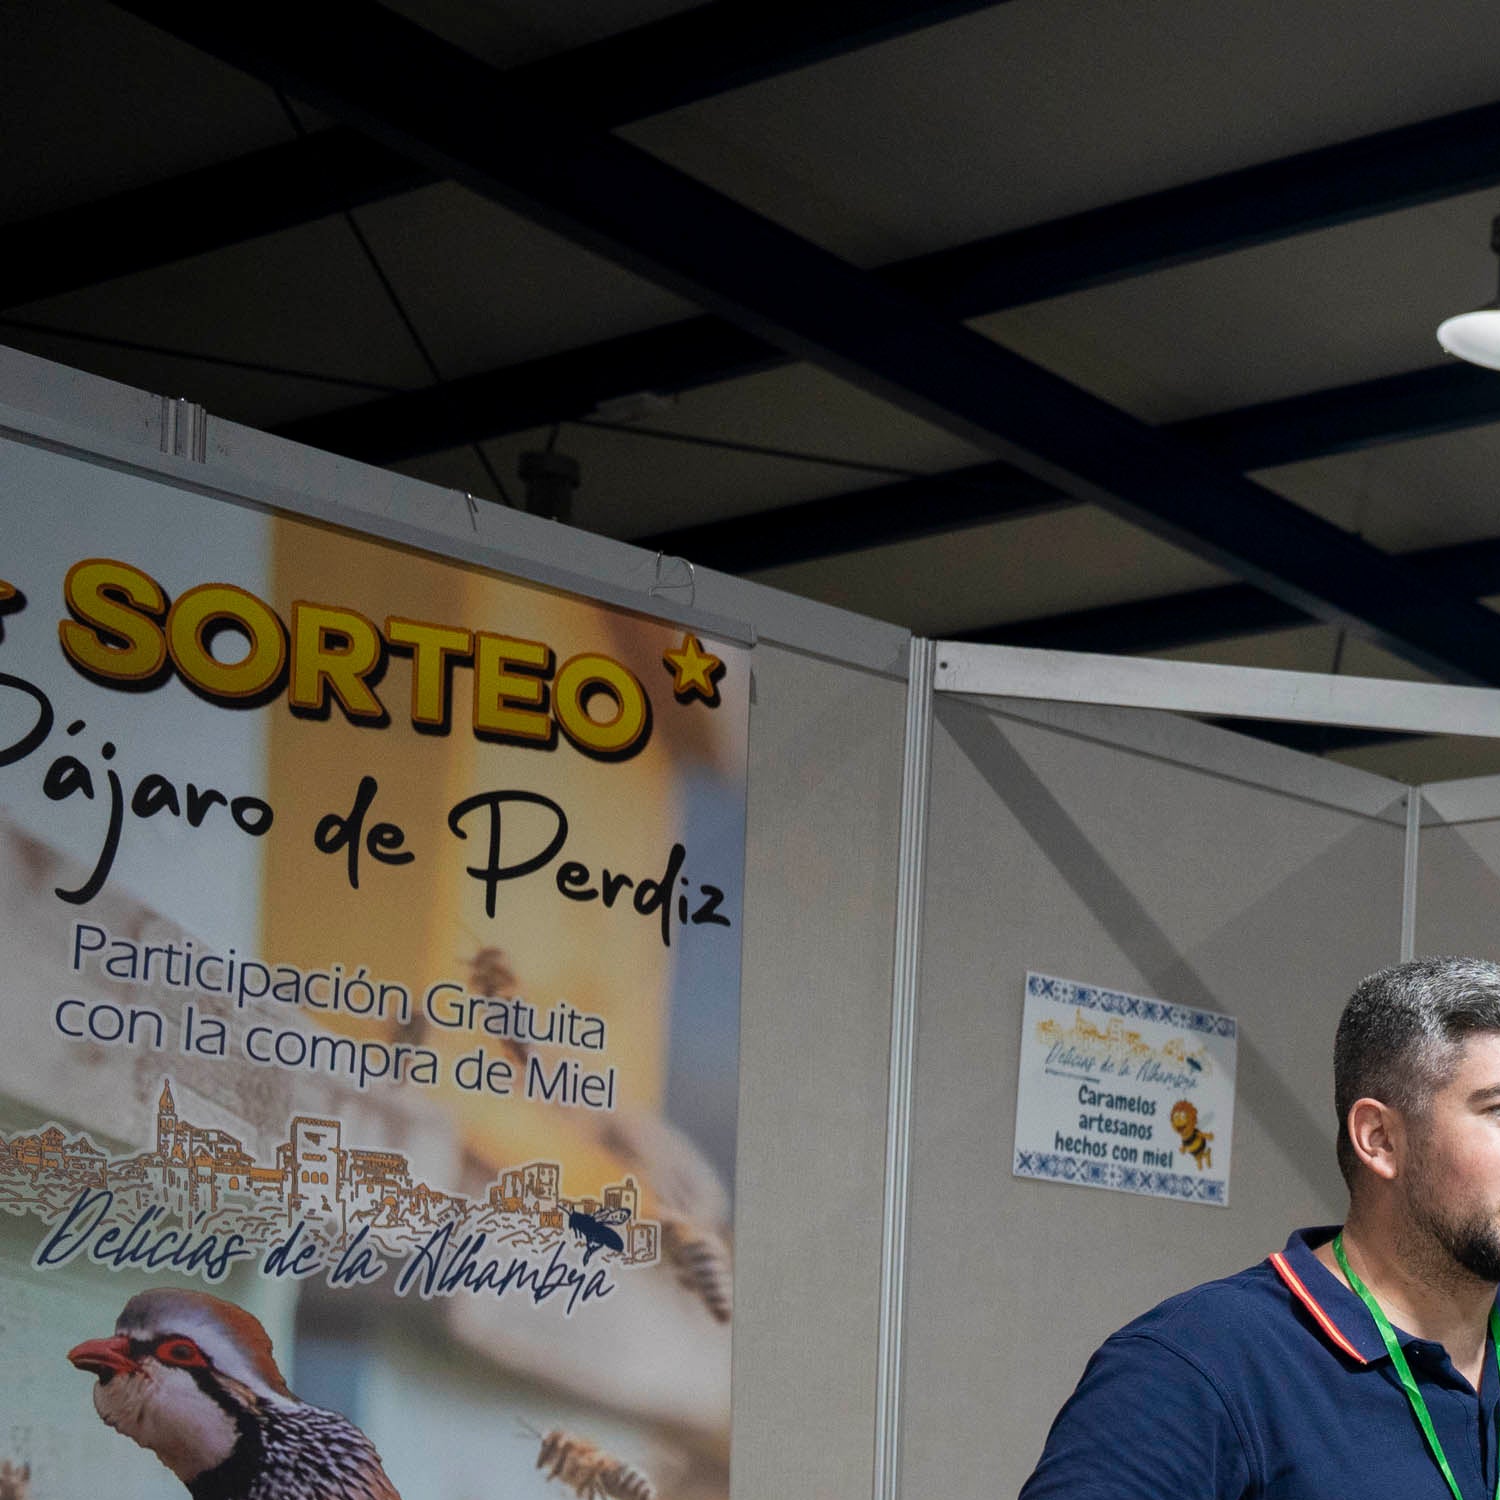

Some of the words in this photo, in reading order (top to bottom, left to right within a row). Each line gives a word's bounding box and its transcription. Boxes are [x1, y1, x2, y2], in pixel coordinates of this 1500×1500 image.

[58, 557, 651, 762] SORTEO
[314, 777, 415, 889] de
[448, 790, 731, 947] Perdiz
[72, 924, 408, 1022] Participación
[427, 982, 606, 1050] Gratuita
[55, 998, 163, 1047] con
[185, 1007, 227, 1056] la
[245, 1022, 438, 1088] compra
[454, 1051, 511, 1096] de
[528, 1058, 616, 1109] Miel
[1078, 1085, 1156, 1116] Caramelos
[1055, 1131, 1107, 1157] hechos
[1112, 1143, 1138, 1163] con
[1142, 1148, 1174, 1169] miel
[1079, 1113, 1153, 1140] artesanos
[37, 1187, 252, 1281] Delicias
[264, 1220, 319, 1282] de
[328, 1227, 382, 1295] la
[399, 1223, 616, 1315] Alhambra
